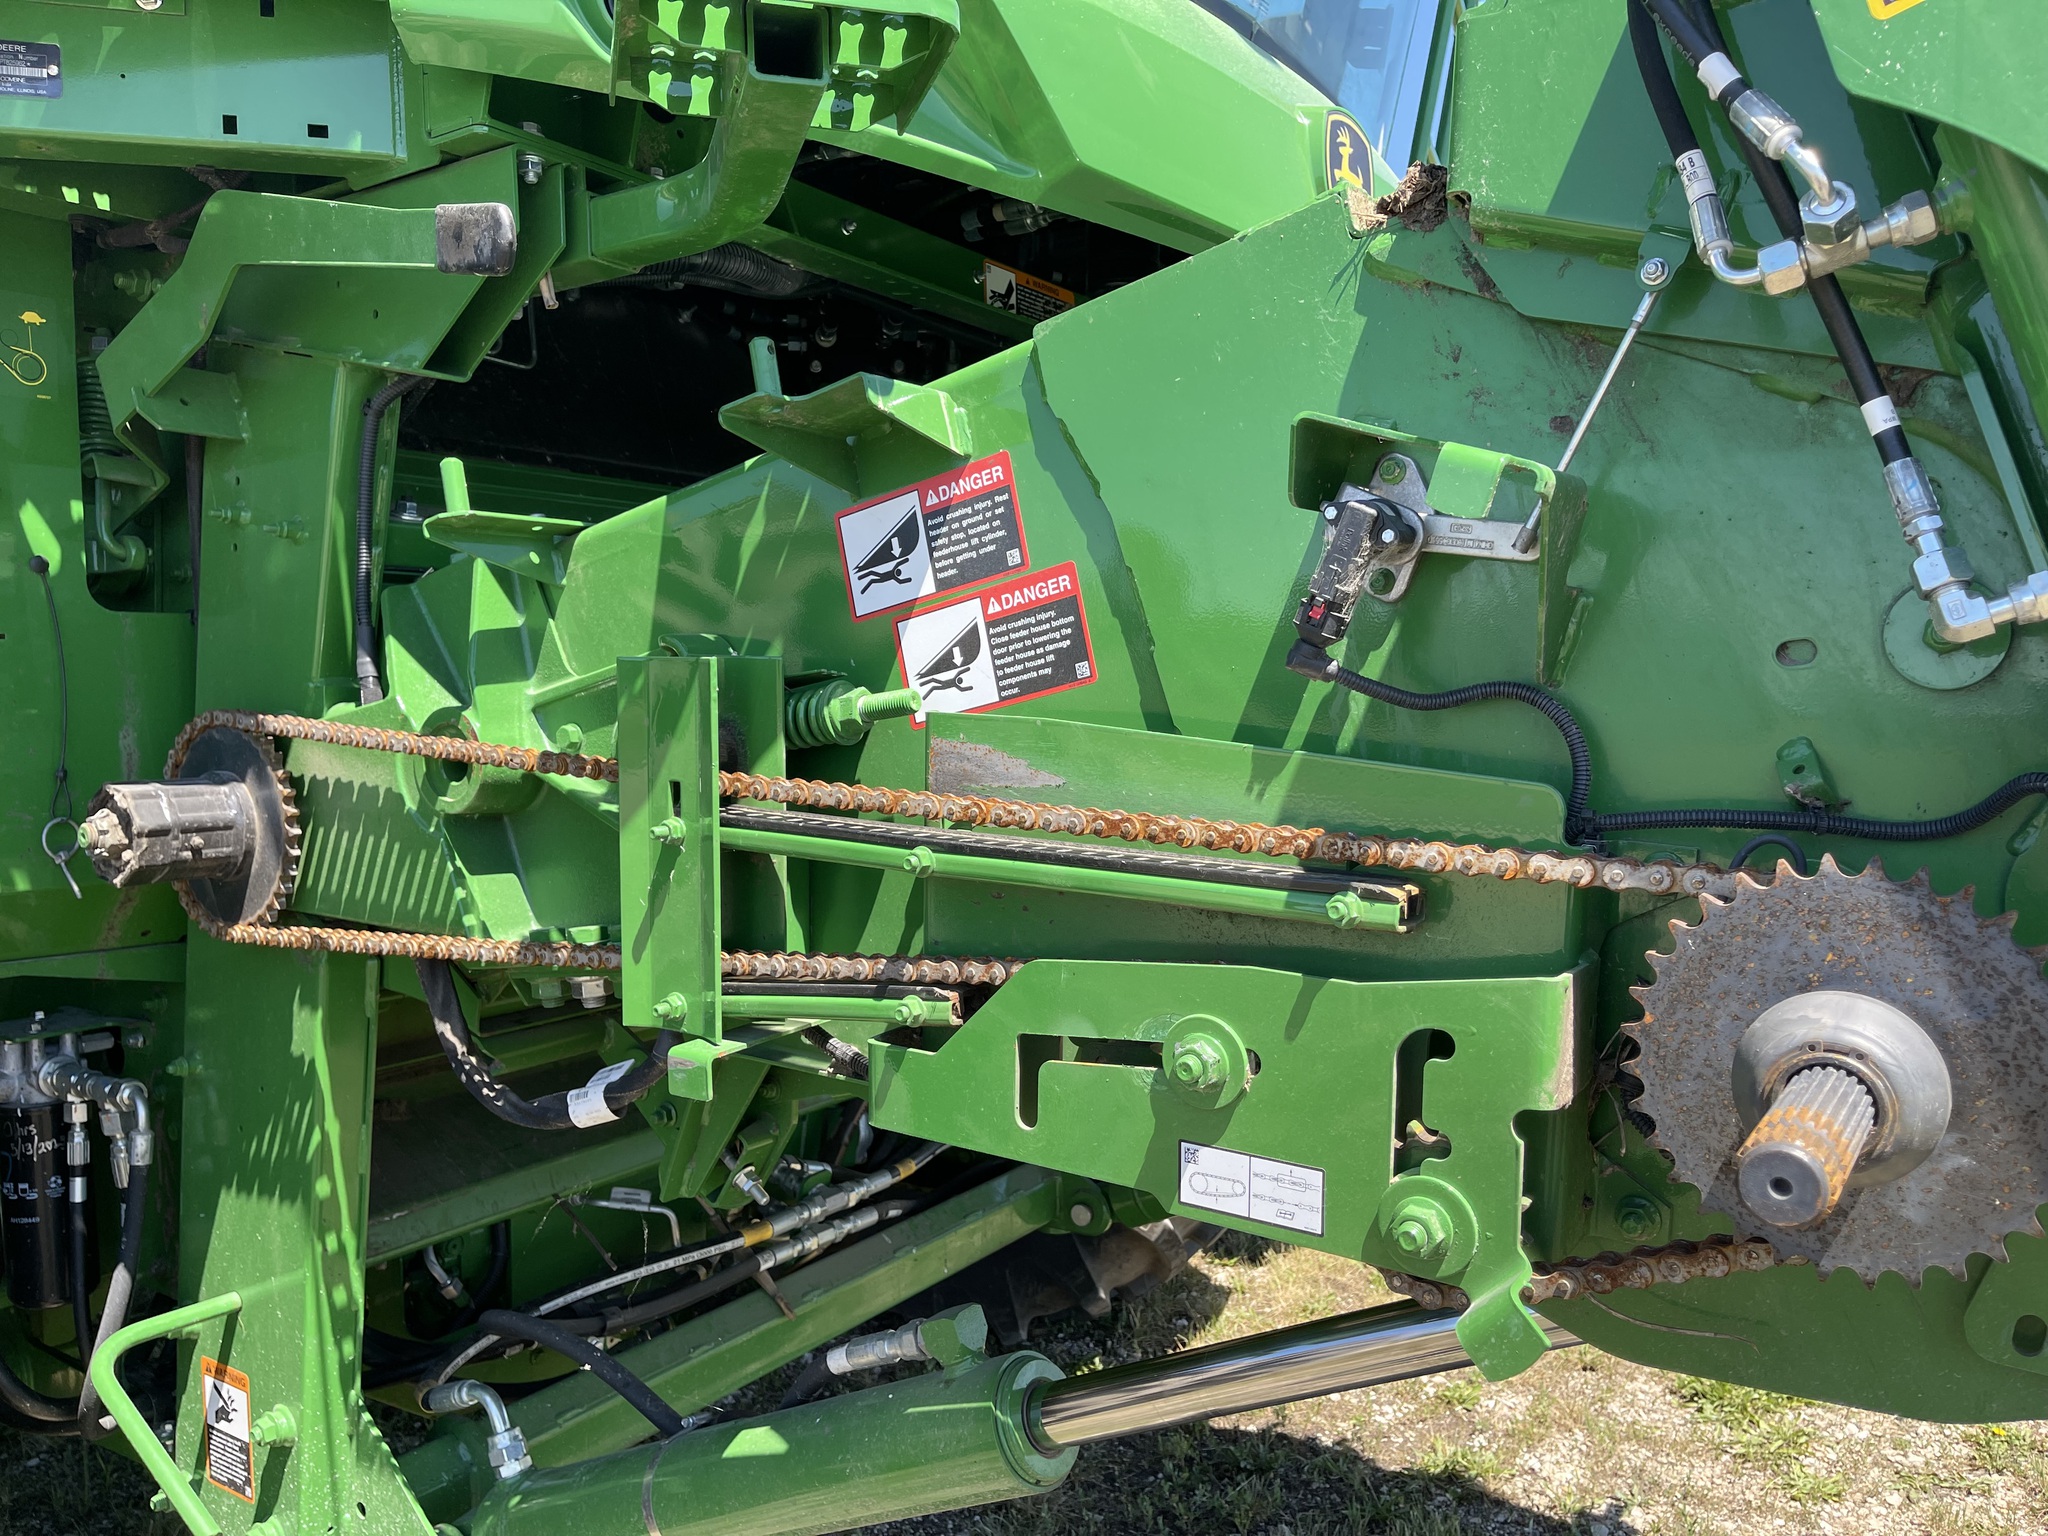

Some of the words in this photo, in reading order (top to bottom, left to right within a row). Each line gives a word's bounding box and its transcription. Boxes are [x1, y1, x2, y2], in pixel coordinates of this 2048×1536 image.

[939, 465, 1004, 502] DANGER
[927, 515, 944, 526] Avoid
[946, 506, 971, 522] crushing
[974, 499, 993, 512] injury.
[995, 493, 1009, 504] Rest
[929, 525, 949, 537] header
[952, 521, 959, 529] on
[962, 513, 983, 528] ground
[985, 512, 992, 520] or
[995, 506, 1004, 515] set
[931, 534, 949, 548] safety
[951, 528, 966, 541] stop,
[968, 522, 990, 535] located
[992, 519, 1000, 527] on
[933, 541, 969, 557] feederhouse
[971, 537, 979, 546] lift
[981, 528, 1007, 544] cylinder,
[935, 557, 953, 569] before
[956, 548, 976, 564] getting
[979, 543, 996, 555] under
[937, 567, 959, 579] header.
[1002, 575, 1071, 611] DANGER
[989, 623, 1006, 635] Avoid
[1008, 615, 1035, 630] crushing
[1036, 610, 1056, 623] injury.
[991, 633, 1009, 645] Close
[1010, 627, 1029, 640] feeder
[1031, 623, 1049, 635] house
[1052, 615, 1074, 630] bottom
[993, 643, 1007, 655] door
[1008, 641, 1023, 654] prior
[1025, 638, 1031, 646] to
[1033, 631, 1058, 646] lowering
[1060, 627, 1072, 637] the
[994, 653, 1014, 665] feeder
[1016, 648, 1034, 660] house
[1036, 646, 1043, 654] as
[1045, 638, 1070, 654] damage
[996, 667, 1003, 676] to
[1005, 661, 1024, 674] feeder
[1026, 656, 1044, 667] house
[1046, 654, 1055, 663] lift
[999, 671, 1037, 687] components
[1039, 667, 1052, 678] may
[1001, 687, 1020, 697] occur.
[16, 1122, 37, 1137] hrs
[214, 1364, 246, 1388] WARNING
